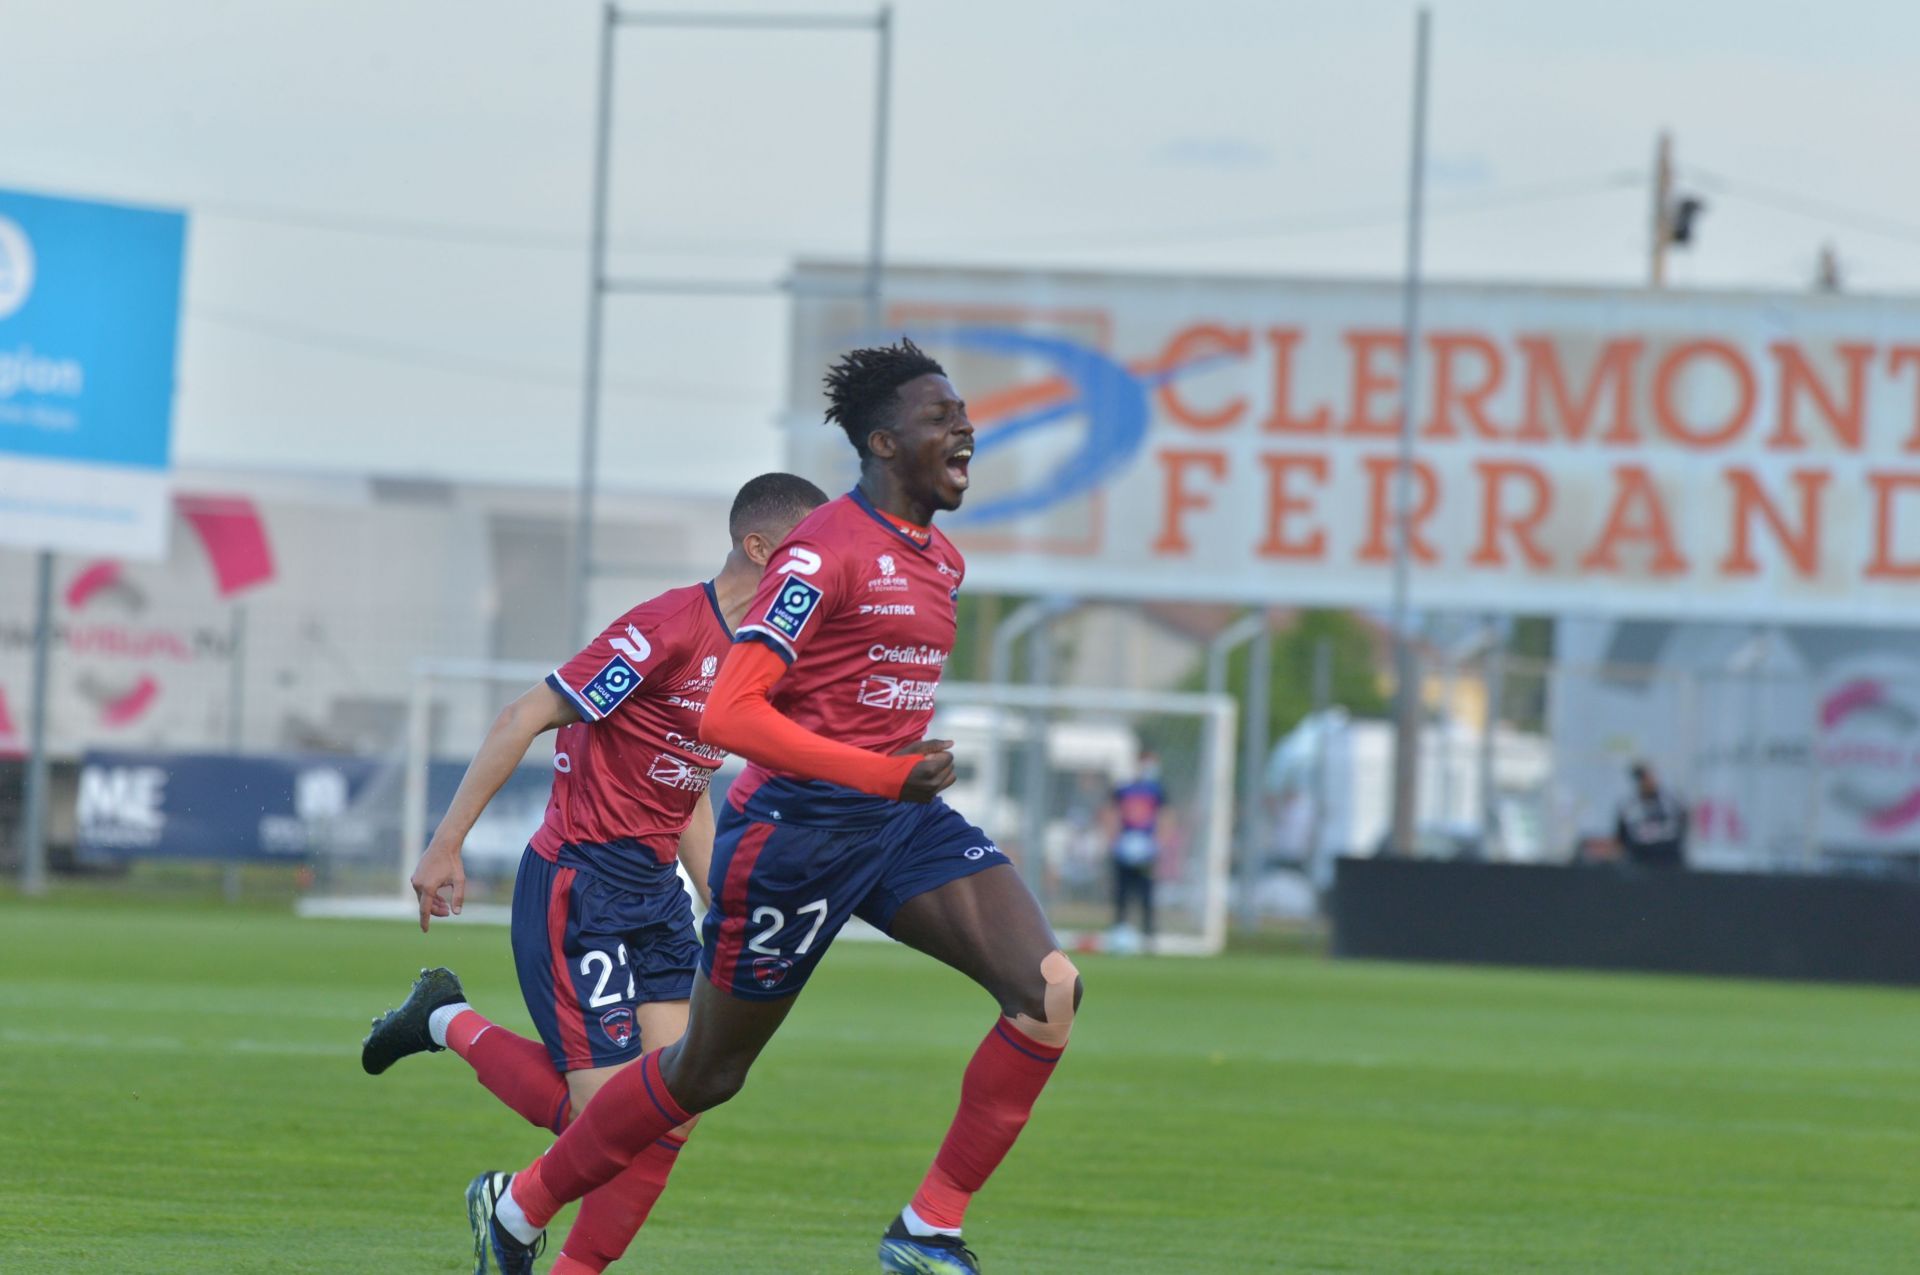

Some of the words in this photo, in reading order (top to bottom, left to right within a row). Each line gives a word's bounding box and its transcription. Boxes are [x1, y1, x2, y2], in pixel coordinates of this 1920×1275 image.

[873, 604, 916, 616] PATRICK
[868, 644, 916, 664] Crédit
[593, 682, 611, 700] LIGUE
[666, 732, 711, 759] Crédit
[749, 898, 828, 956] 27
